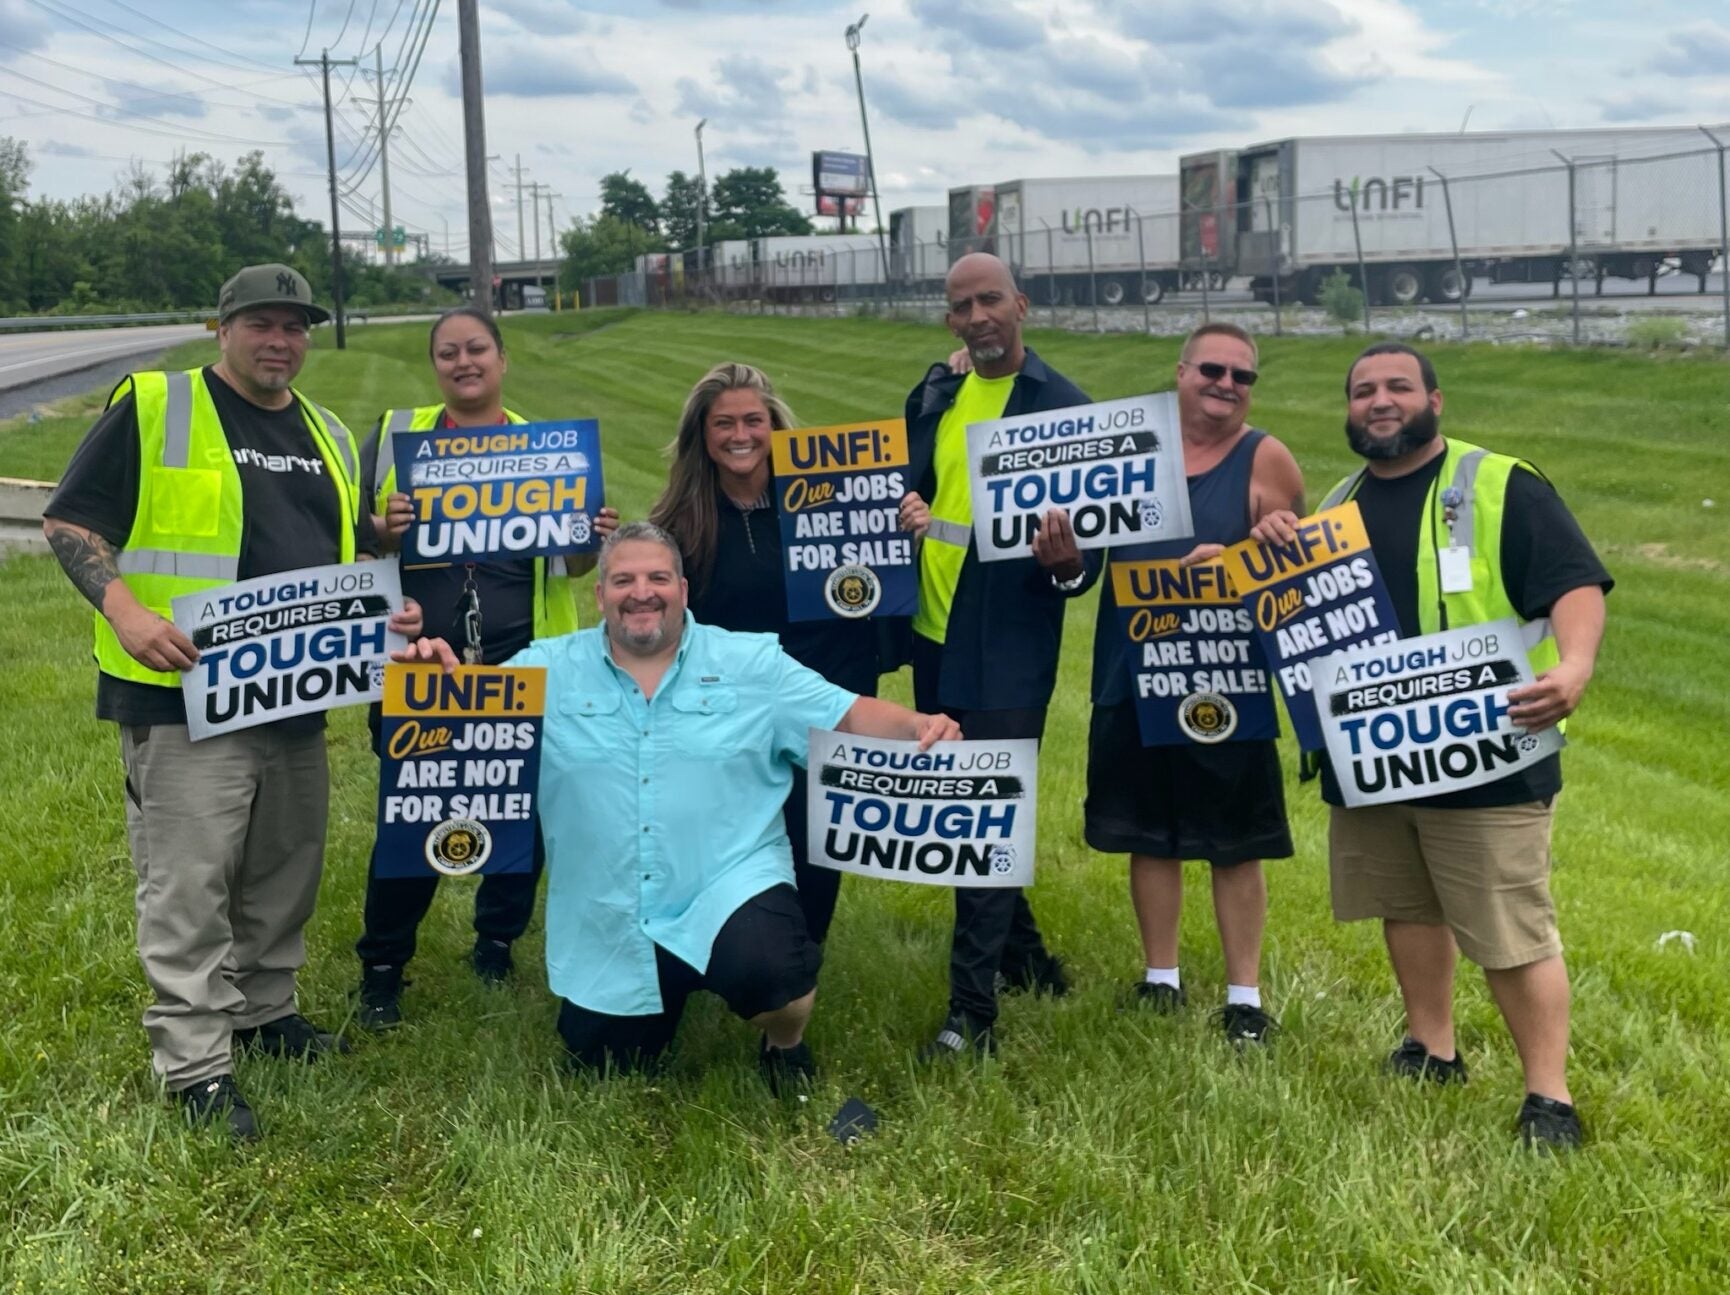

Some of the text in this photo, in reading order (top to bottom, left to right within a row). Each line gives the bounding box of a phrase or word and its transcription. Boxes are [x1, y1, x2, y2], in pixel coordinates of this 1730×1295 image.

[1334, 176, 1424, 212] UNFI
[1062, 207, 1130, 234] UNFI
[416, 430, 578, 458] A TOUGH JOB
[989, 408, 1144, 448] A TOUGH JOB
[426, 456, 571, 480] REQUIRES A
[790, 430, 891, 469] UNFI:
[998, 436, 1136, 470] REQUIRES A
[414, 476, 586, 522] TOUGH
[784, 472, 904, 512] Our JOBS
[987, 458, 1156, 512] TOUGH
[416, 513, 570, 558] UNION
[796, 508, 899, 538] ARE NOT
[788, 539, 912, 571] FOR SALE!
[1240, 519, 1348, 581] UNFI:
[201, 572, 374, 620] A TOUGH JOB
[1257, 558, 1374, 632] Our JOBS
[212, 600, 365, 643] REQUIRES A
[1128, 608, 1254, 642] Our JOBS
[1276, 616, 1328, 659] ARE
[1324, 596, 1380, 641] NOT
[199, 622, 386, 687] TOUGH
[1143, 640, 1250, 668] ARE NOT
[1335, 634, 1499, 685] A TOUGH JOB
[206, 661, 370, 724] UNION
[405, 672, 526, 711] UNFI:
[1137, 669, 1267, 698] FOR SALE!
[1279, 662, 1313, 696] FO
[1348, 666, 1496, 709] REQUIRES A
[388, 720, 535, 760] Our JOBS
[1340, 694, 1510, 754] TOUGH
[397, 759, 524, 788] ARE NOT
[832, 744, 1012, 771] A TOUGH JOB
[1352, 734, 1520, 794] UNION
[840, 770, 998, 796] REQUIRES A
[386, 793, 531, 823] FOR SALE!
[825, 791, 1016, 839] TOUGH
[824, 828, 992, 876] UNION
